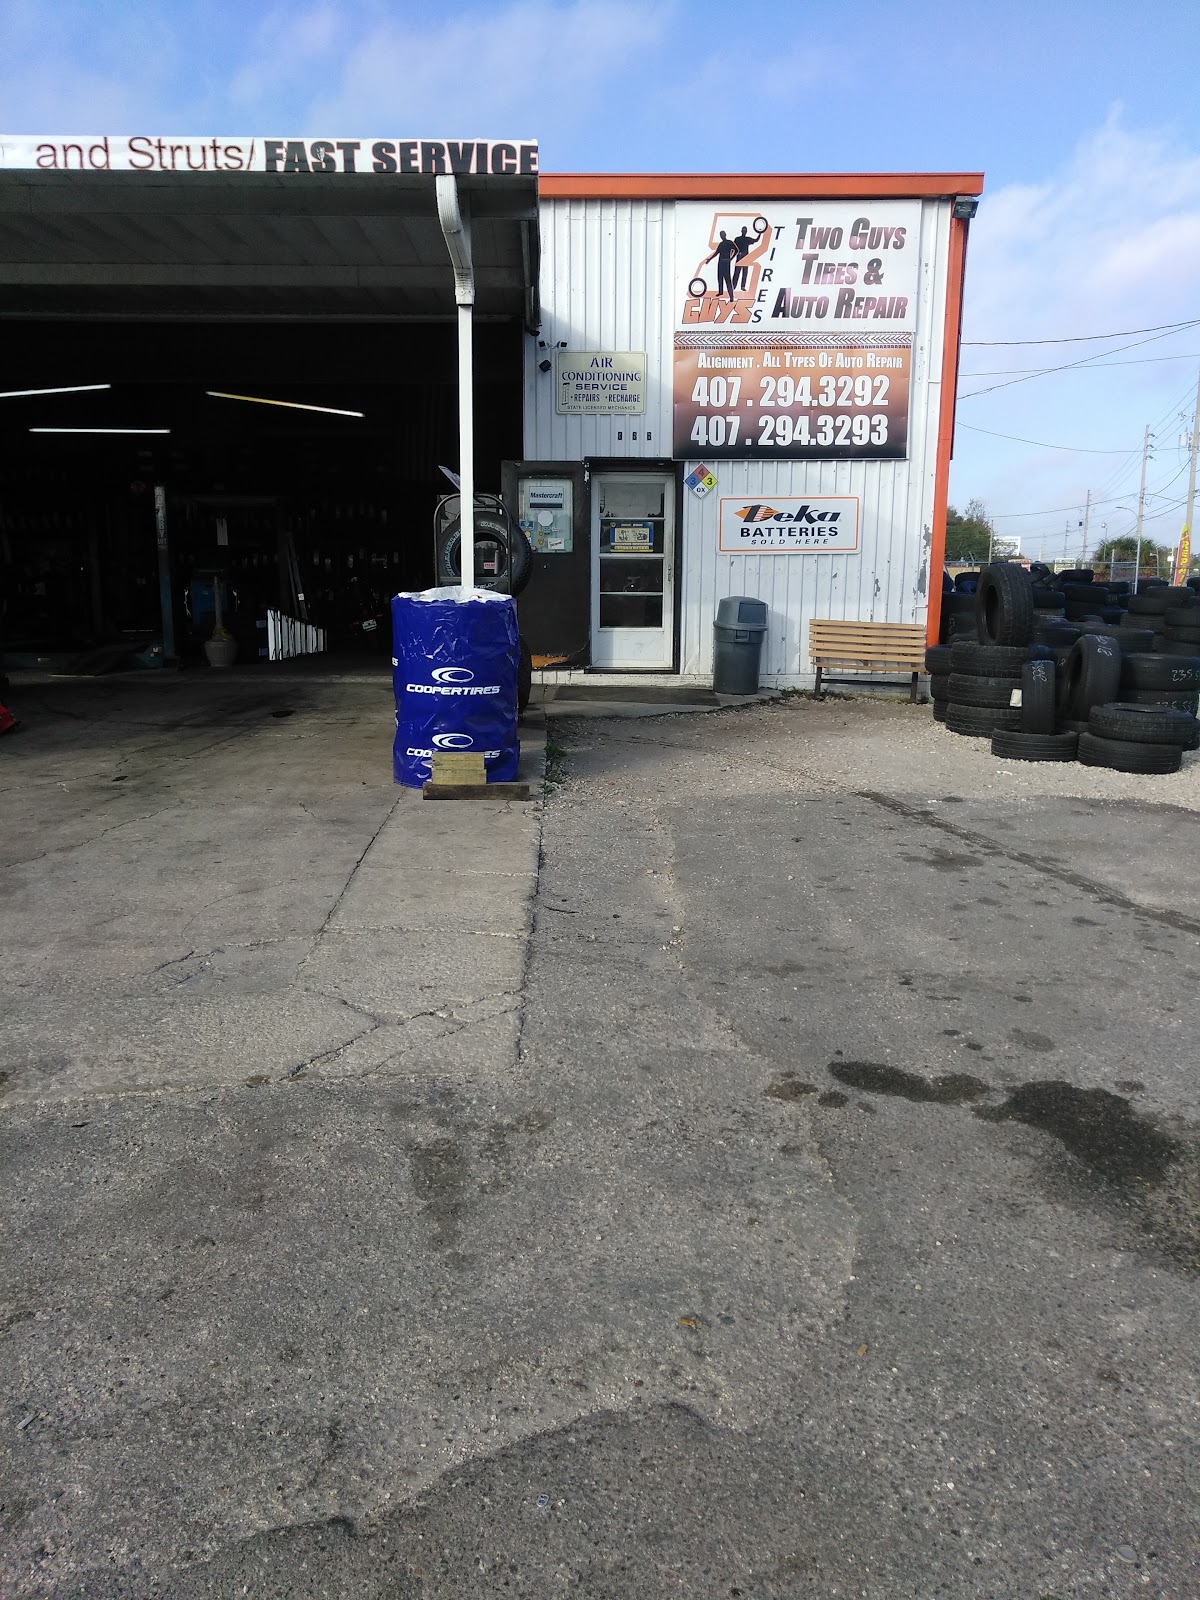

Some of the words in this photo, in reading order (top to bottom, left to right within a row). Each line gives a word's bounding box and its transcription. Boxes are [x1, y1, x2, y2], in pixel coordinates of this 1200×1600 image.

[36, 136, 110, 169] and
[264, 140, 361, 173] FAST
[371, 141, 539, 175] SERVICE
[863, 258, 884, 285] &
[682, 298, 757, 324] GUYS
[590, 357, 613, 368] AIR
[562, 372, 642, 381] CONDITIONING
[575, 383, 628, 391] SERVICE
[690, 477, 696, 485] 3
[706, 477, 713, 485] 3
[742, 504, 842, 524] Deka
[740, 527, 838, 538] BATTERIES
